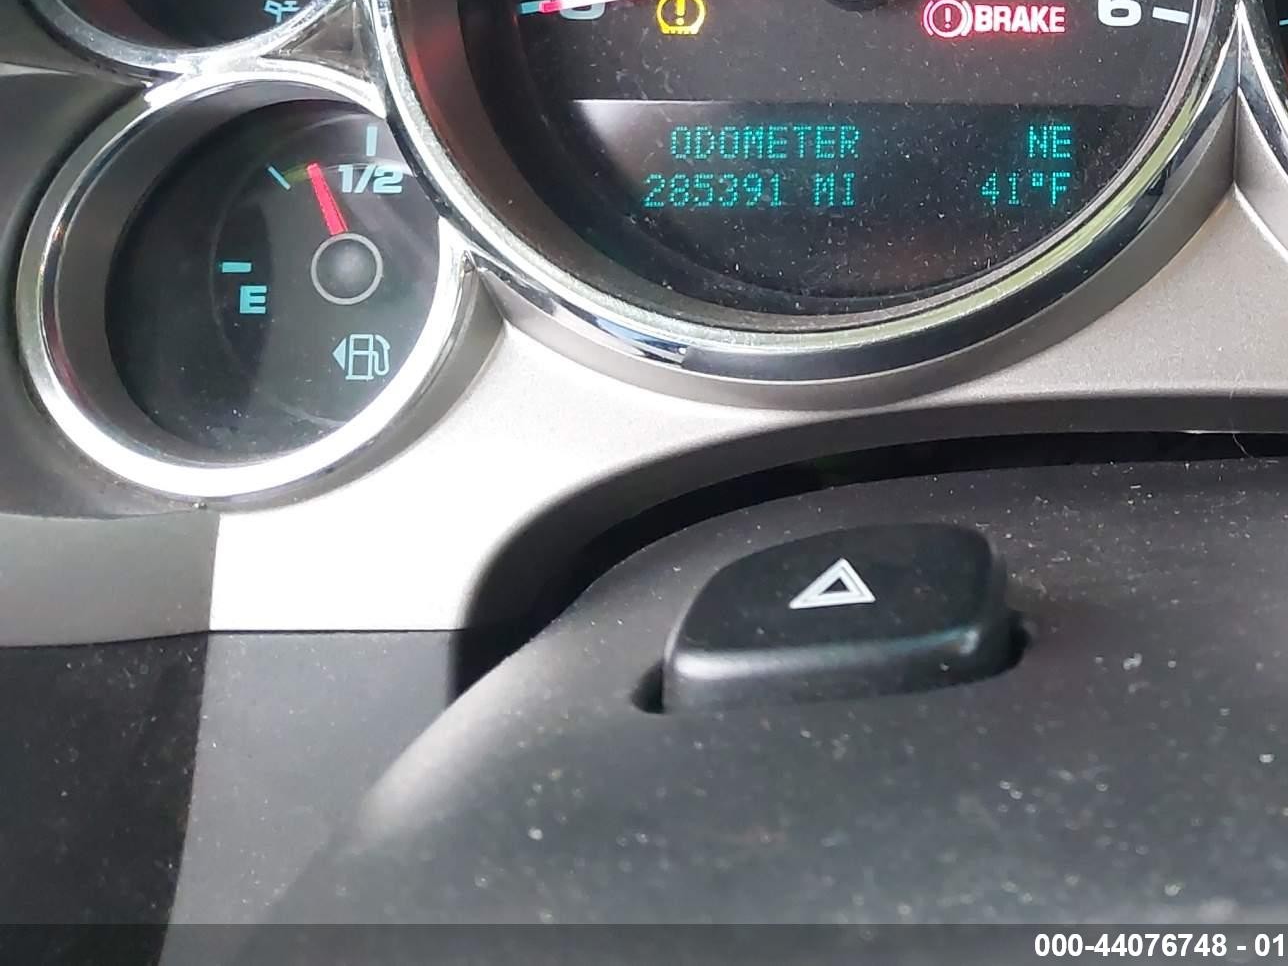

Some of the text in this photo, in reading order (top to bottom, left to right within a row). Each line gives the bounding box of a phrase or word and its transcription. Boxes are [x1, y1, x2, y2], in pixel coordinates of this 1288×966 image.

[975, 5, 1066, 34] BRAKE
[670, 125, 860, 160] ODOMETER
[1029, 124, 1072, 159] NE
[339, 164, 402, 194] 1/2
[642, 172, 856, 209] 285391 MI
[980, 171, 1072, 207] 41°F
[239, 285, 267, 314] E
